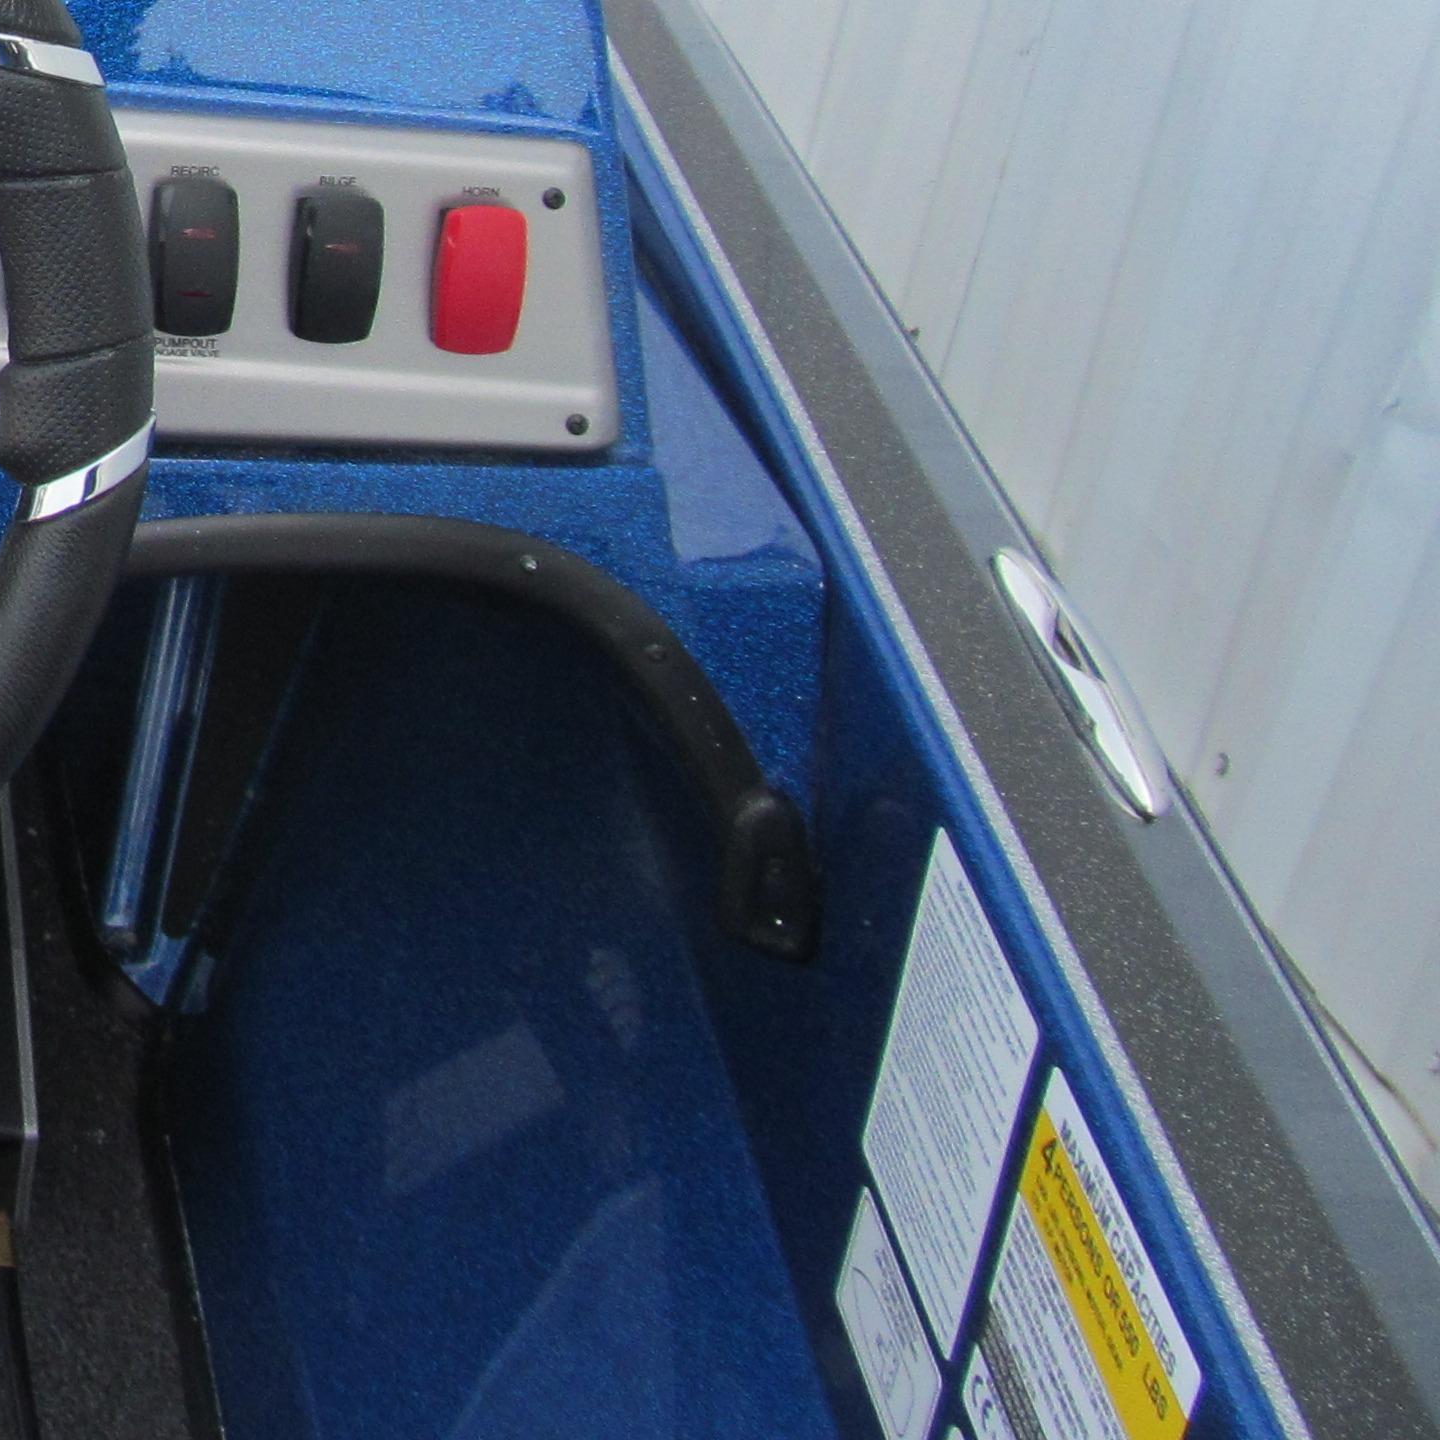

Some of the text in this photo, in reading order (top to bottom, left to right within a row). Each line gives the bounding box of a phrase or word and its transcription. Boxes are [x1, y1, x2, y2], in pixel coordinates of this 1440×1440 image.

[170, 165, 221, 177] RECIRC
[320, 176, 357, 187] BILGE
[462, 186, 501, 198] HORN
[1058, 1117, 1113, 1231] MAXIMUM
[1109, 1229, 1177, 1379] CAPACITIES
[1040, 1136, 1058, 1177] 4
[1055, 1167, 1103, 1280] PERSONS
[1101, 1273, 1121, 1315] OR
[1141, 1361, 1169, 1423] LBS
